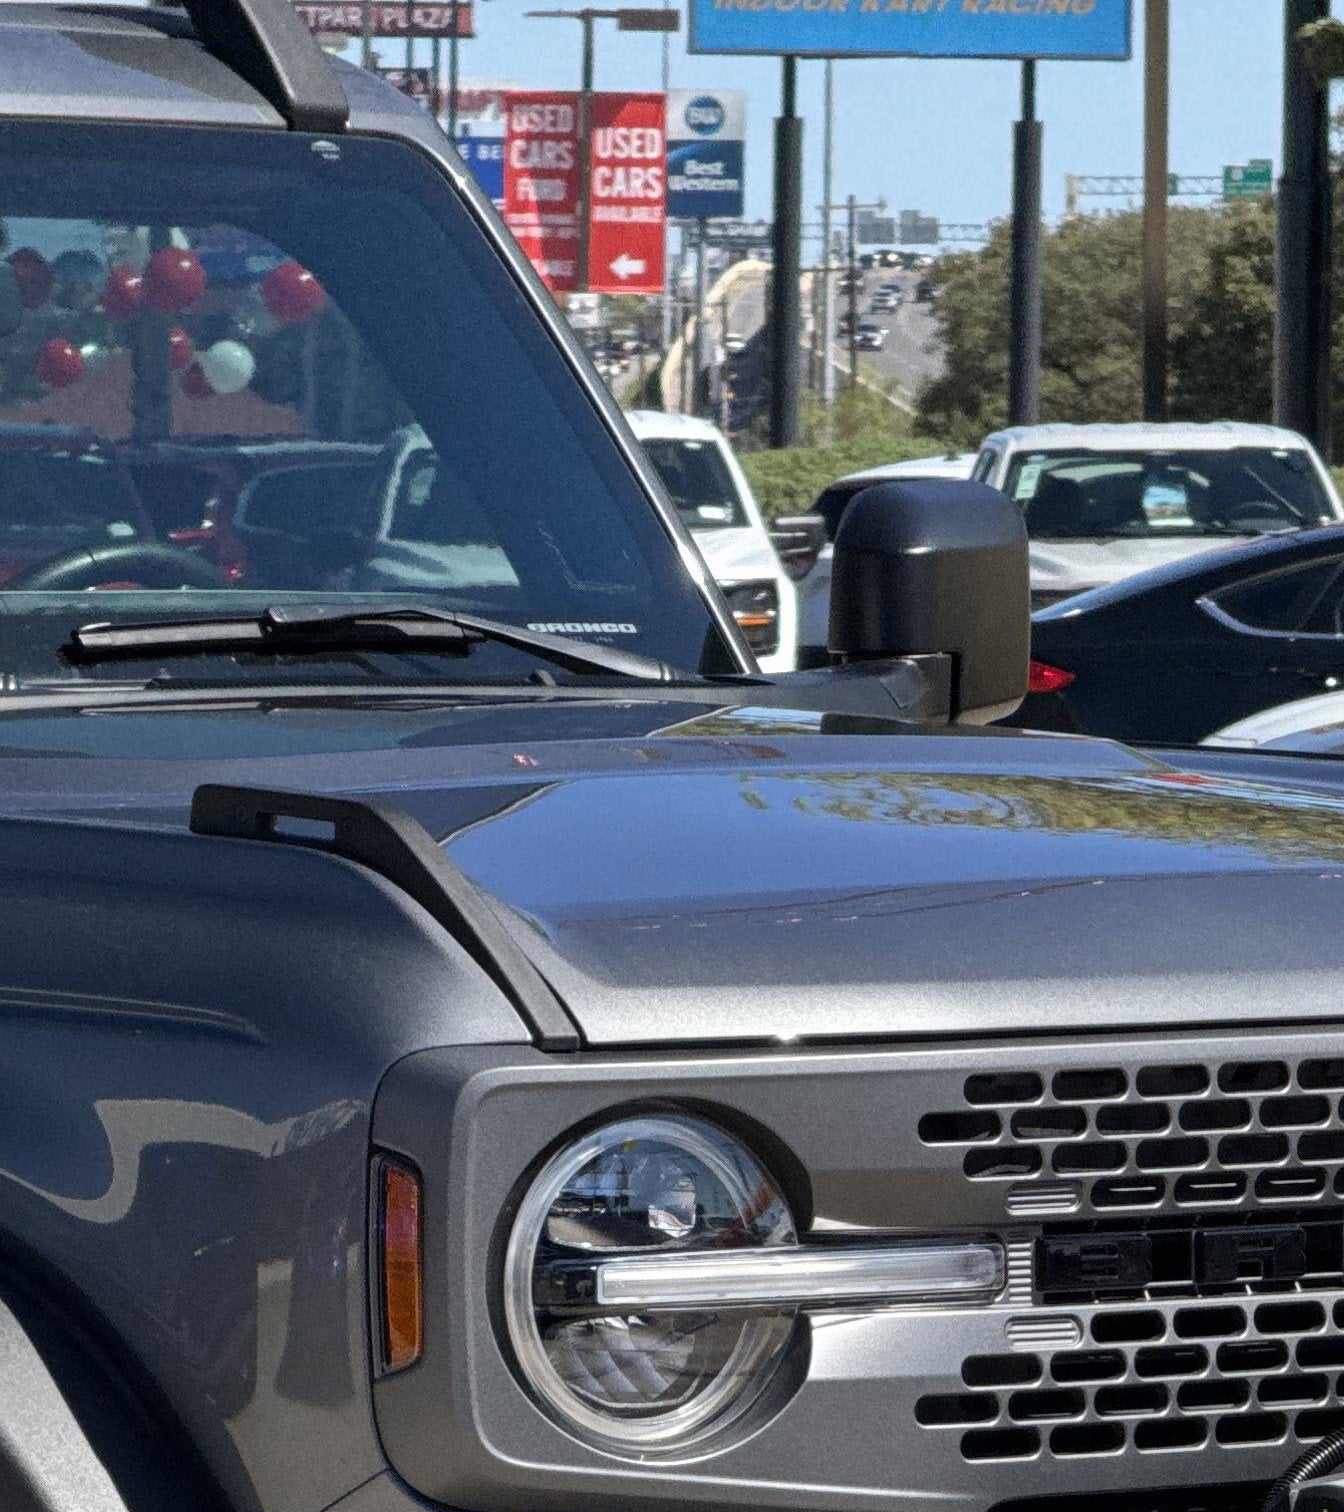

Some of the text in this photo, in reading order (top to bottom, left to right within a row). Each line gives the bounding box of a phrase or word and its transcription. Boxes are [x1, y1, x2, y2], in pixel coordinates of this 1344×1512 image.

[511, 103, 574, 133] USED
[510, 138, 575, 169] CARS
[592, 127, 662, 158] USED
[592, 165, 664, 198] CARS
[682, 159, 725, 176] Best
